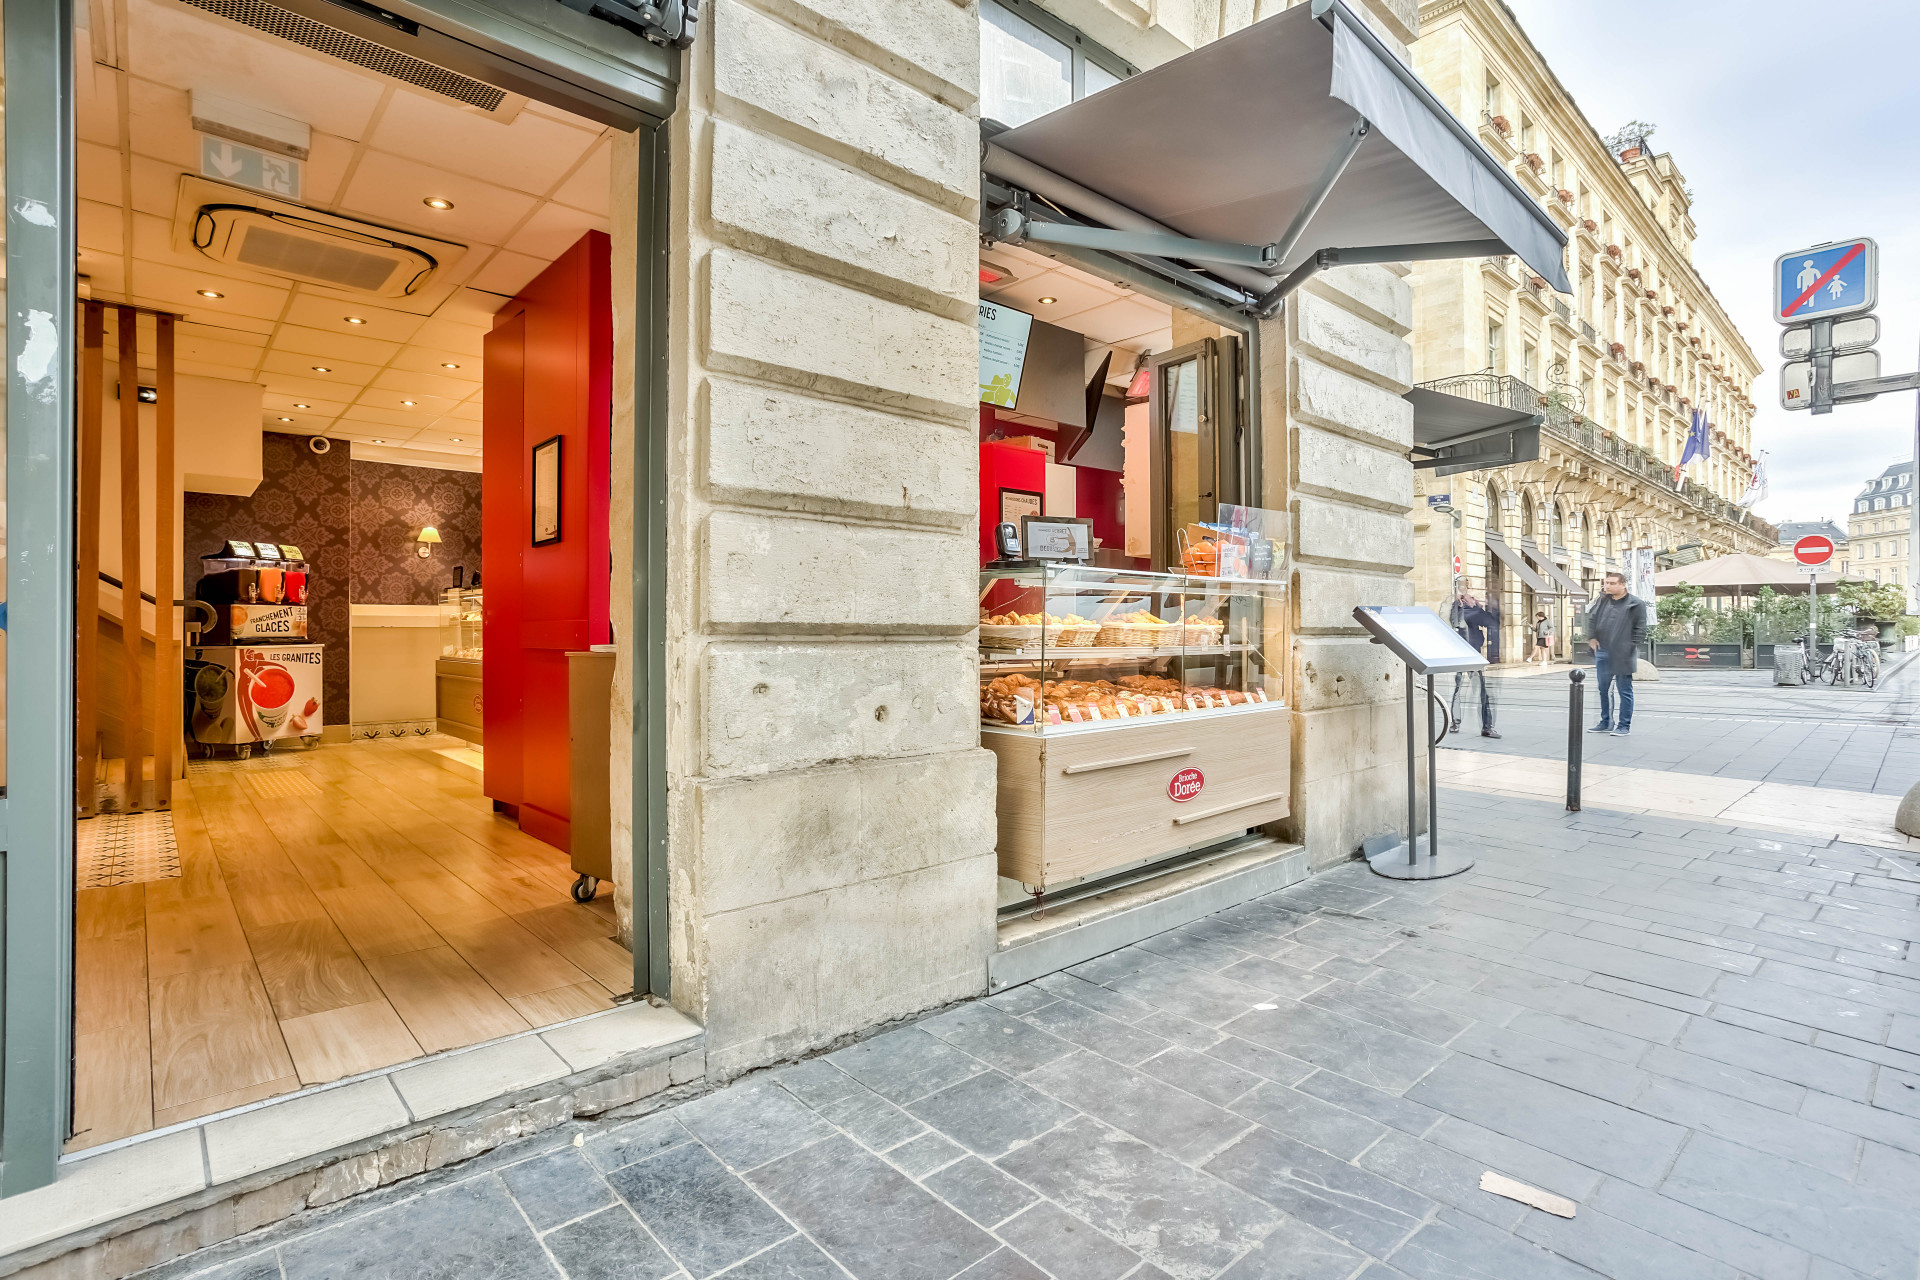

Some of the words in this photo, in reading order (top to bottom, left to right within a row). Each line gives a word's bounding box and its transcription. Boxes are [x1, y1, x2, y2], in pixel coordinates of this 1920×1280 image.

[250, 607, 293, 624] FRANCHEMENT
[255, 620, 290, 633] GLACES
[270, 653, 280, 661] LES
[1178, 772, 1198, 782] Brioche
[1174, 781, 1201, 797] Dorée
